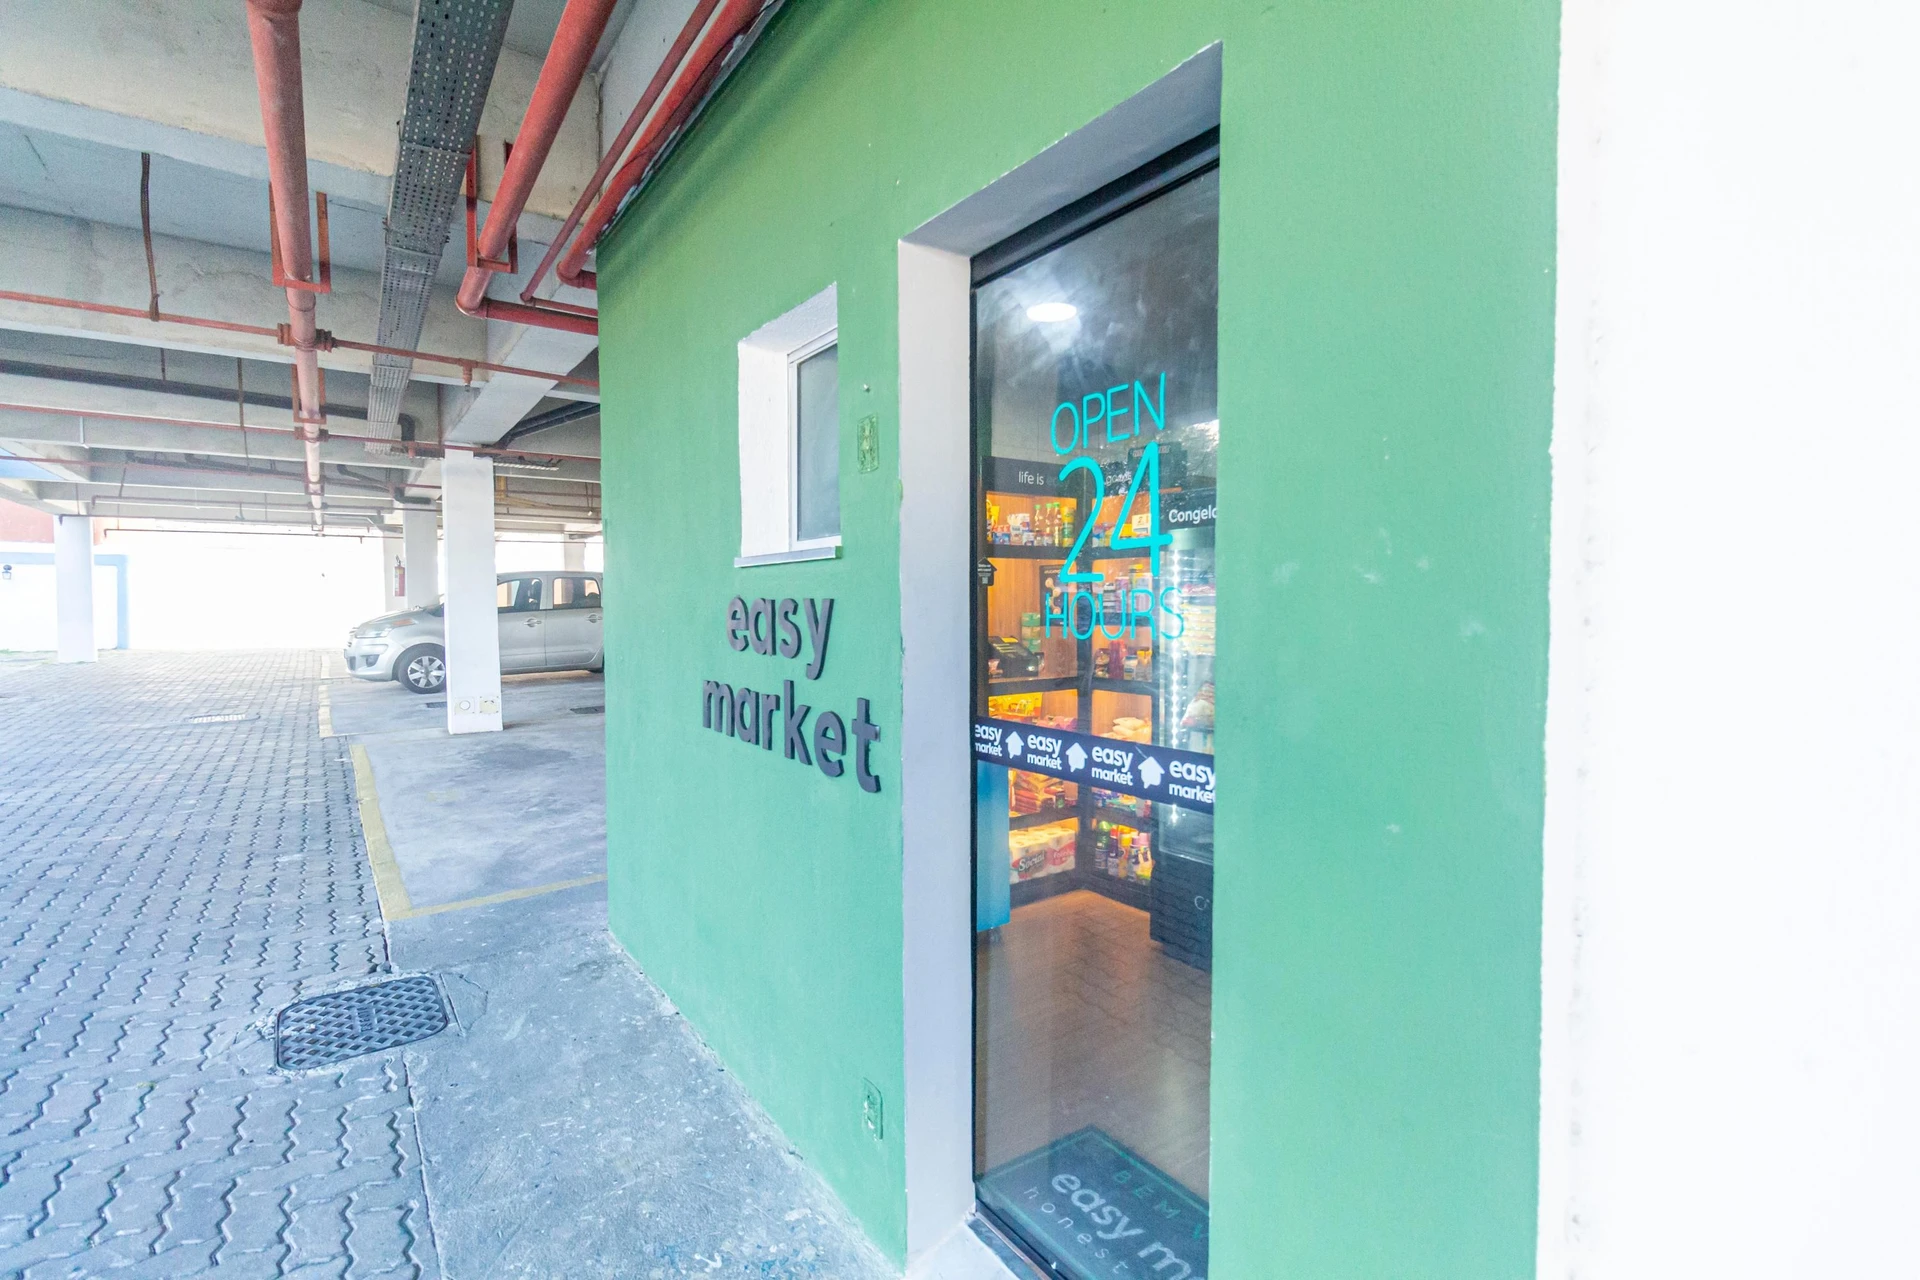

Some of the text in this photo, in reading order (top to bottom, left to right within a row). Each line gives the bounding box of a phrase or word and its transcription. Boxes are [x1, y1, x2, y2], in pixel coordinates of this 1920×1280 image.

[1051, 371, 1166, 455] OPEN
[1018, 471, 1034, 485] life
[1036, 473, 1045, 486] is
[1058, 441, 1174, 583] 24
[726, 594, 835, 680] easy
[1045, 586, 1185, 641] HOURS
[702, 679, 882, 793] market
[1026, 732, 1063, 758] easy
[1026, 752, 1063, 771] market
[1091, 745, 1134, 772] easy
[1091, 767, 1134, 787] market
[1168, 760, 1216, 790] easy
[1022, 1186, 1129, 1275] honest
[1051, 1173, 1146, 1240] easy
